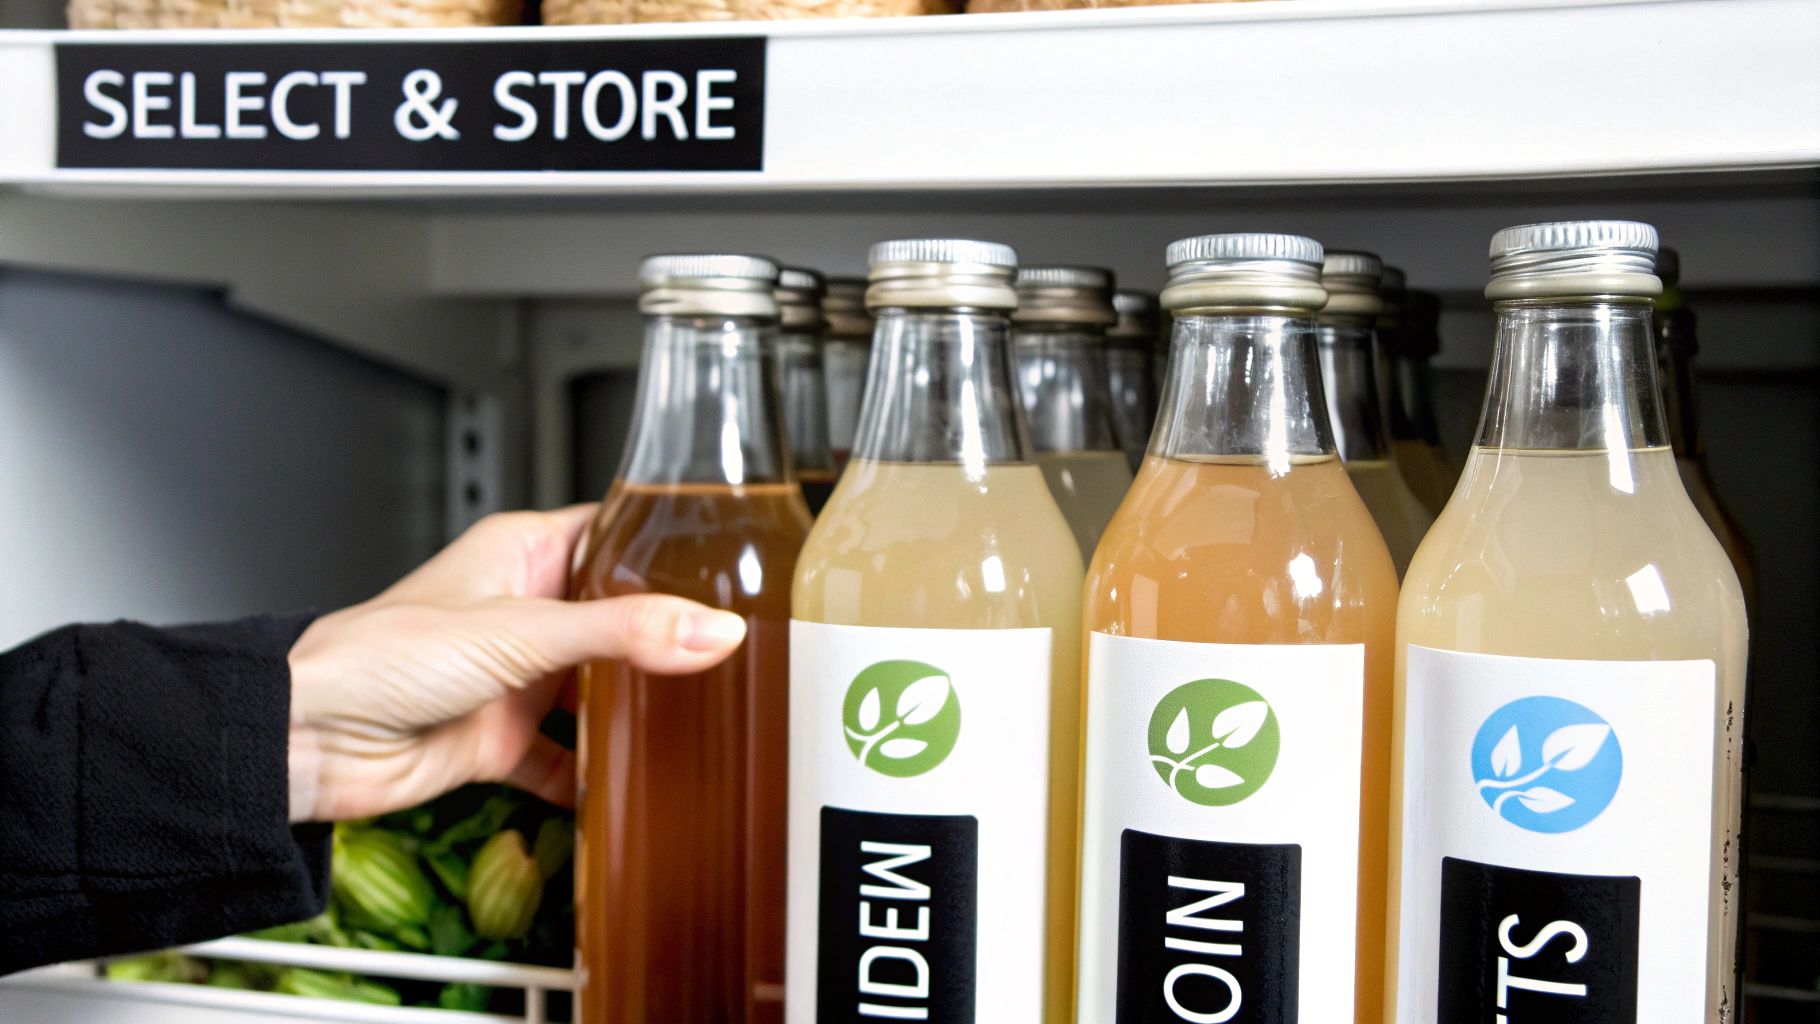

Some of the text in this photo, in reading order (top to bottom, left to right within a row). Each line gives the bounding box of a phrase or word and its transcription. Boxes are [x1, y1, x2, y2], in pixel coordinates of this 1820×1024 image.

[83, 69, 737, 142] SELECT & STORE
[1163, 875, 1245, 1024] OIN
[1496, 913, 1589, 1024] TS
